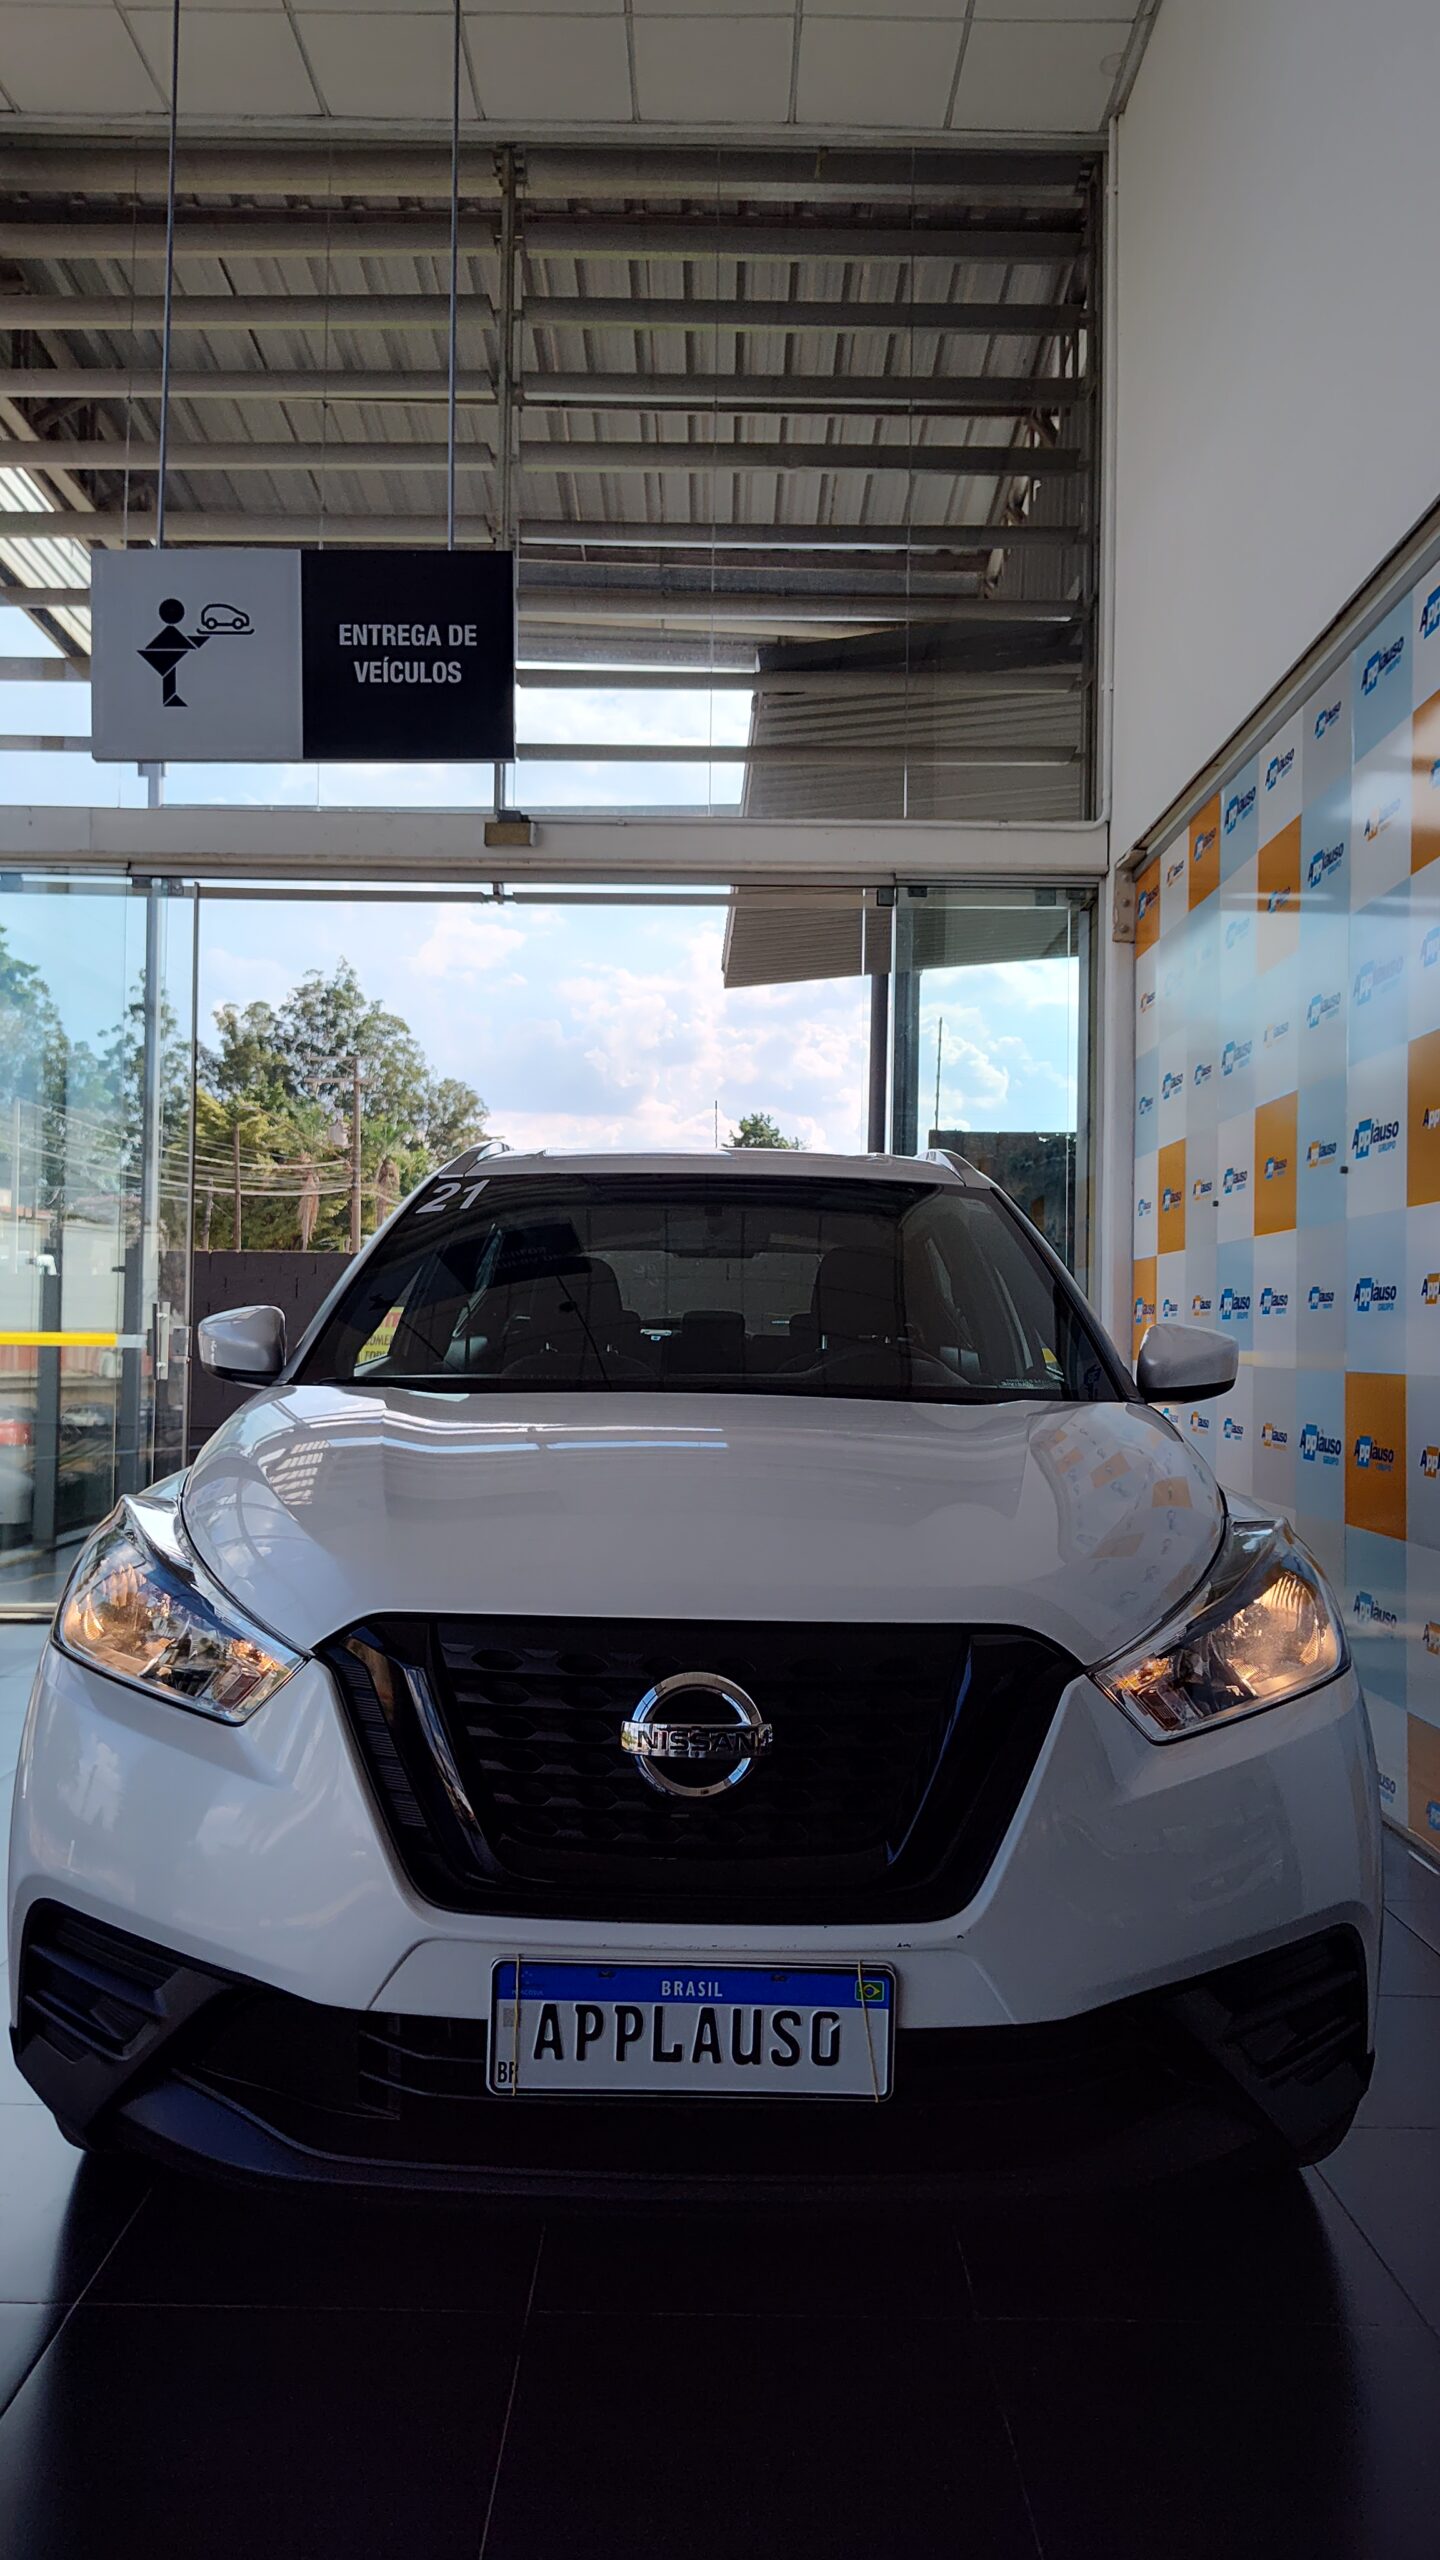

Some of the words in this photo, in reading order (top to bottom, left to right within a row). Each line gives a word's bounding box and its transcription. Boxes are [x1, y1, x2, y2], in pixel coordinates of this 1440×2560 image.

[339, 624, 441, 646] ENTREGA
[448, 624, 478, 646] DE
[354, 656, 463, 684] VEÍCULOS
[415, 1179, 491, 1214] 21
[637, 1729, 759, 1752] NISSAN
[661, 1980, 724, 1998] BRASIL
[532, 2002, 841, 2068] APPLAUSO
